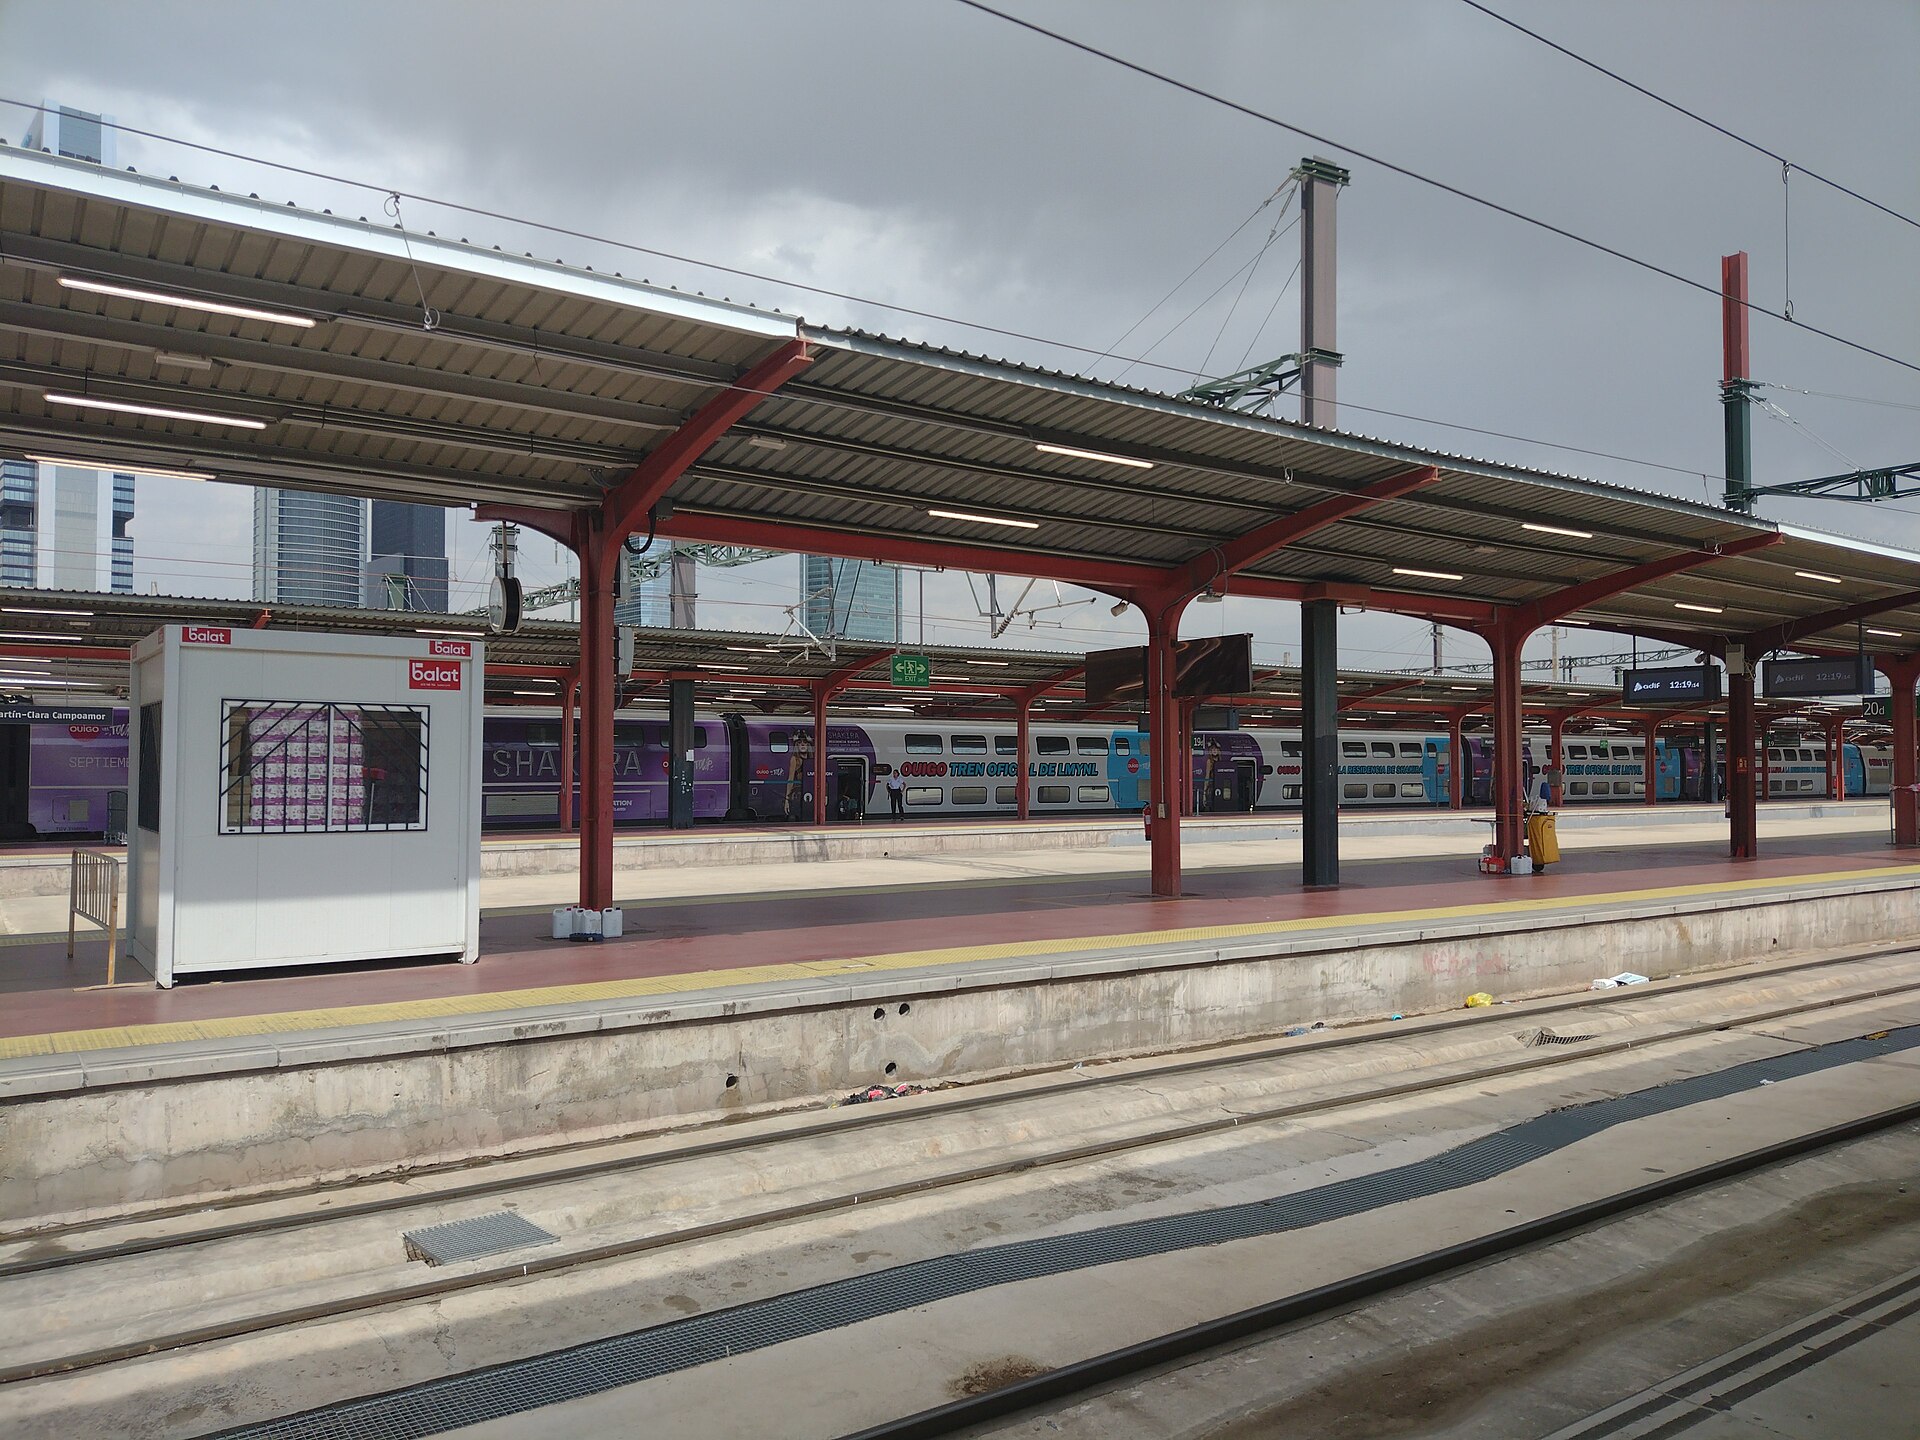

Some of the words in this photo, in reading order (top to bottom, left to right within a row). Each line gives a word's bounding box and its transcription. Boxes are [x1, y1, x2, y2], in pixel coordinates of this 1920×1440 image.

[188, 627, 225, 642] balat
[434, 640, 466, 655] balat
[412, 662, 459, 682] balat
[1643, 682, 1661, 690] adif
[1863, 701, 1885, 715] 20d
[52, 711, 106, 721] Campoamor
[69, 725, 100, 733] OUIGO
[68, 756, 129, 768] SEPTIEM
[493, 750, 643, 777] SHARA
[900, 762, 948, 777] OUIGO
[950, 762, 986, 777] TREN
[987, 762, 1037, 777] OFICL
[1038, 762, 1057, 777] DE
[1057, 763, 1098, 777] LMYNL
